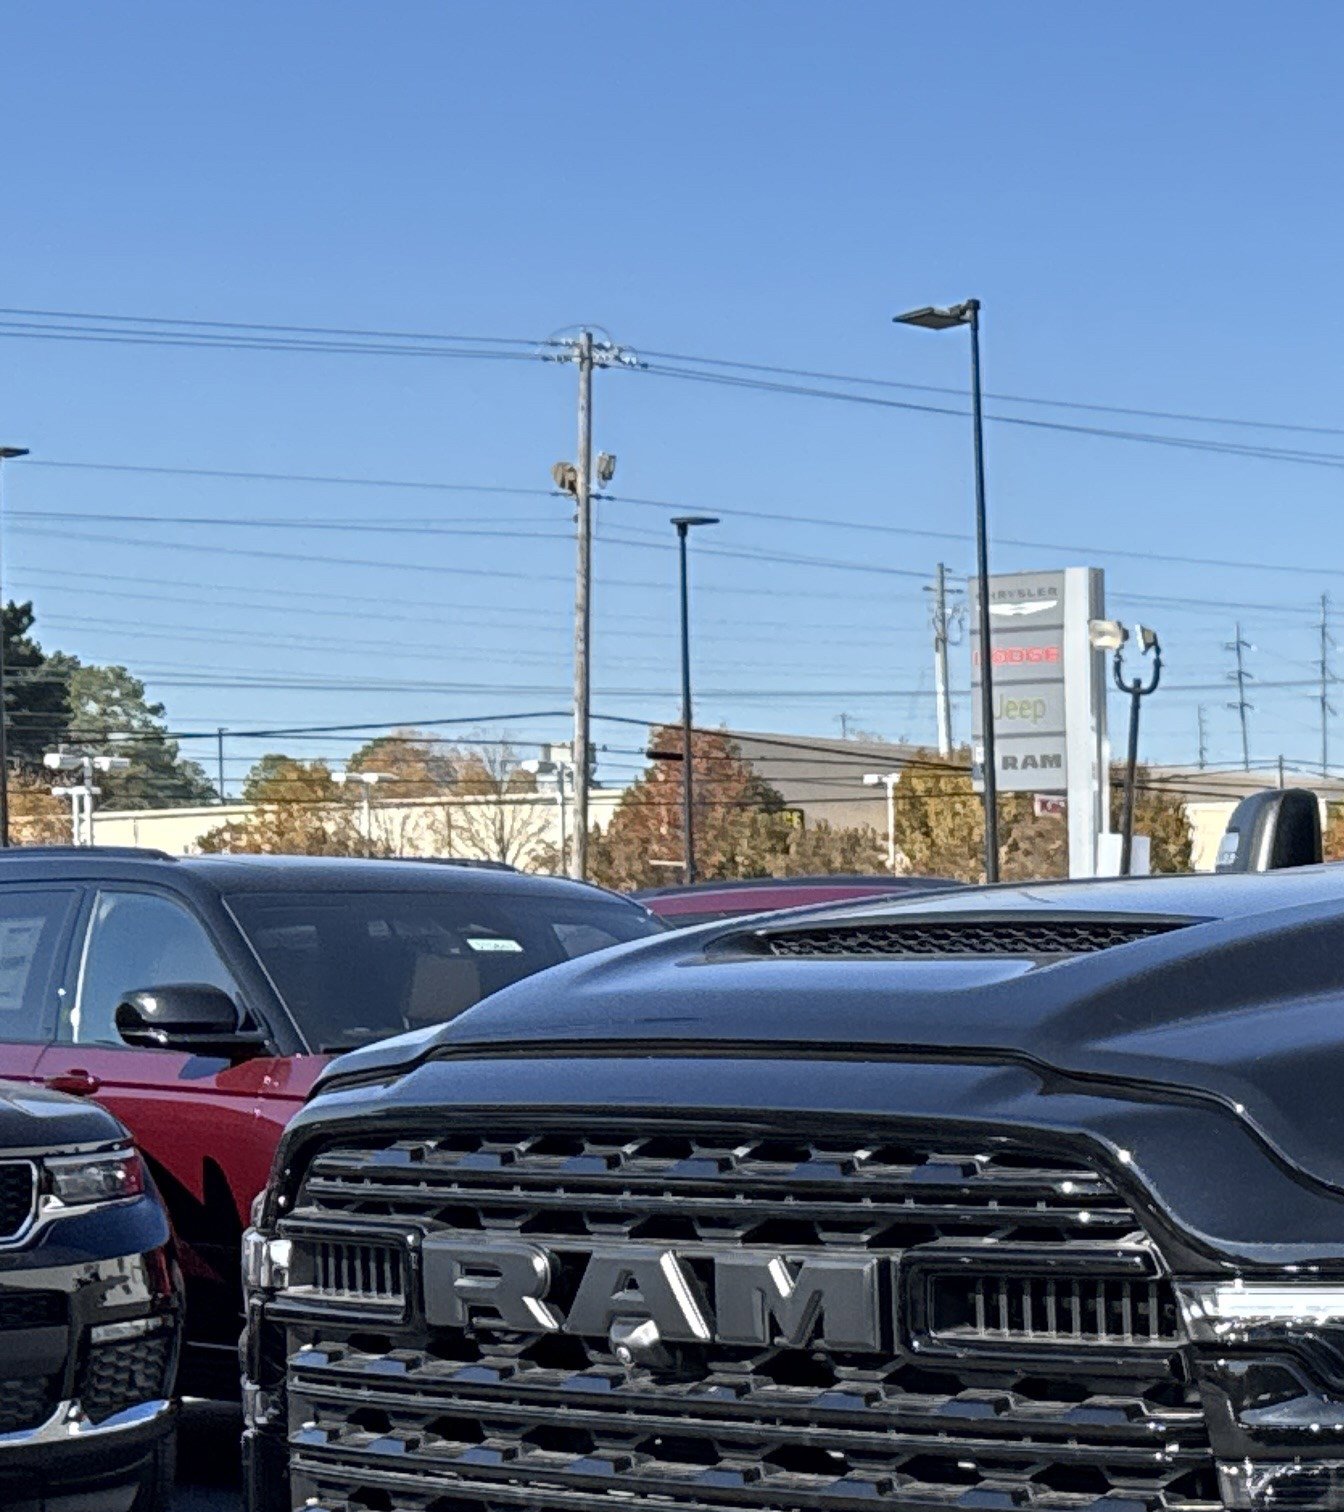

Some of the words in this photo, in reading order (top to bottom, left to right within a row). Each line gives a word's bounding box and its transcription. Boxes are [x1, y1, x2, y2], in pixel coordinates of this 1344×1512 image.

[994, 694, 1046, 725] Jeep
[1002, 753, 1062, 770] RAM
[423, 1237, 888, 1353] RAM
